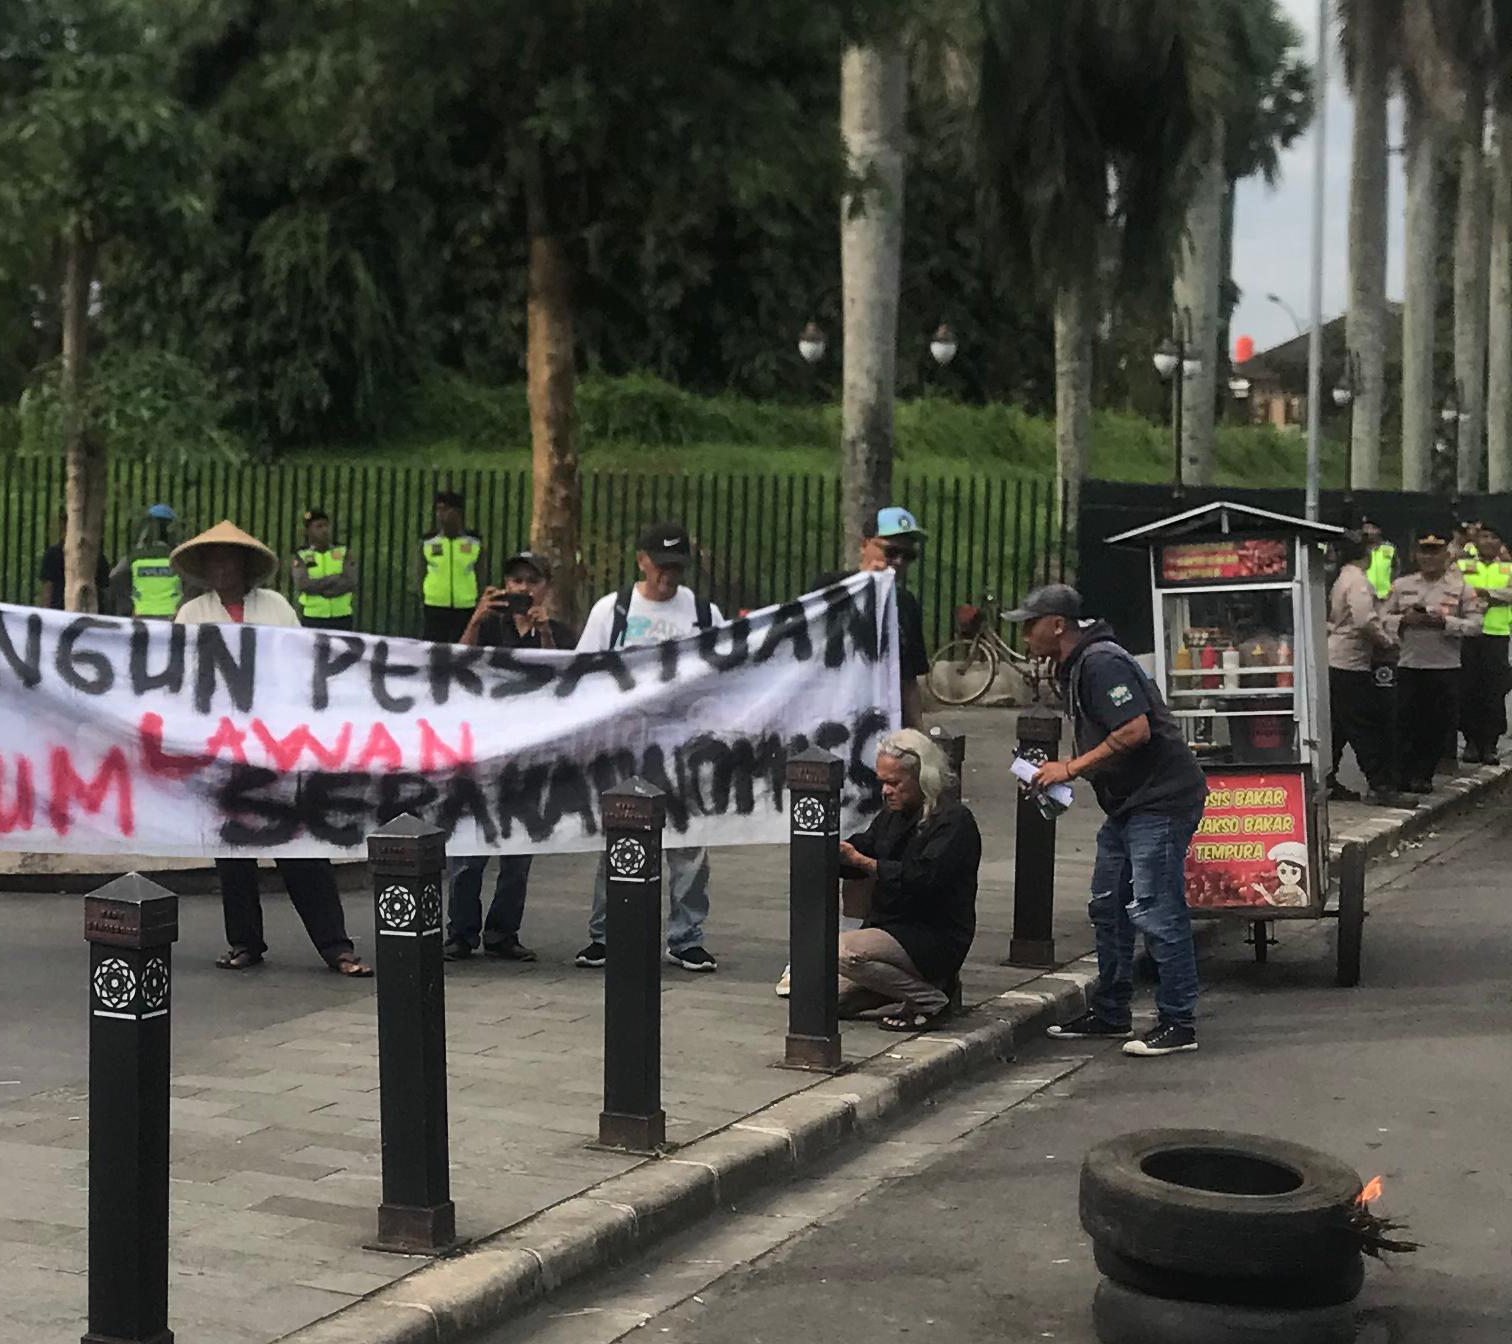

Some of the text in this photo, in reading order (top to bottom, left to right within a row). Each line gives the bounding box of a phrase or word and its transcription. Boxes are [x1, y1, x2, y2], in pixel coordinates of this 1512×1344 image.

[140, 711, 473, 778] LAWAN
[1234, 788, 1284, 808] BAKAR
[1243, 815, 1292, 834] BAKAR
[1194, 844, 1264, 861] TEMPURA
